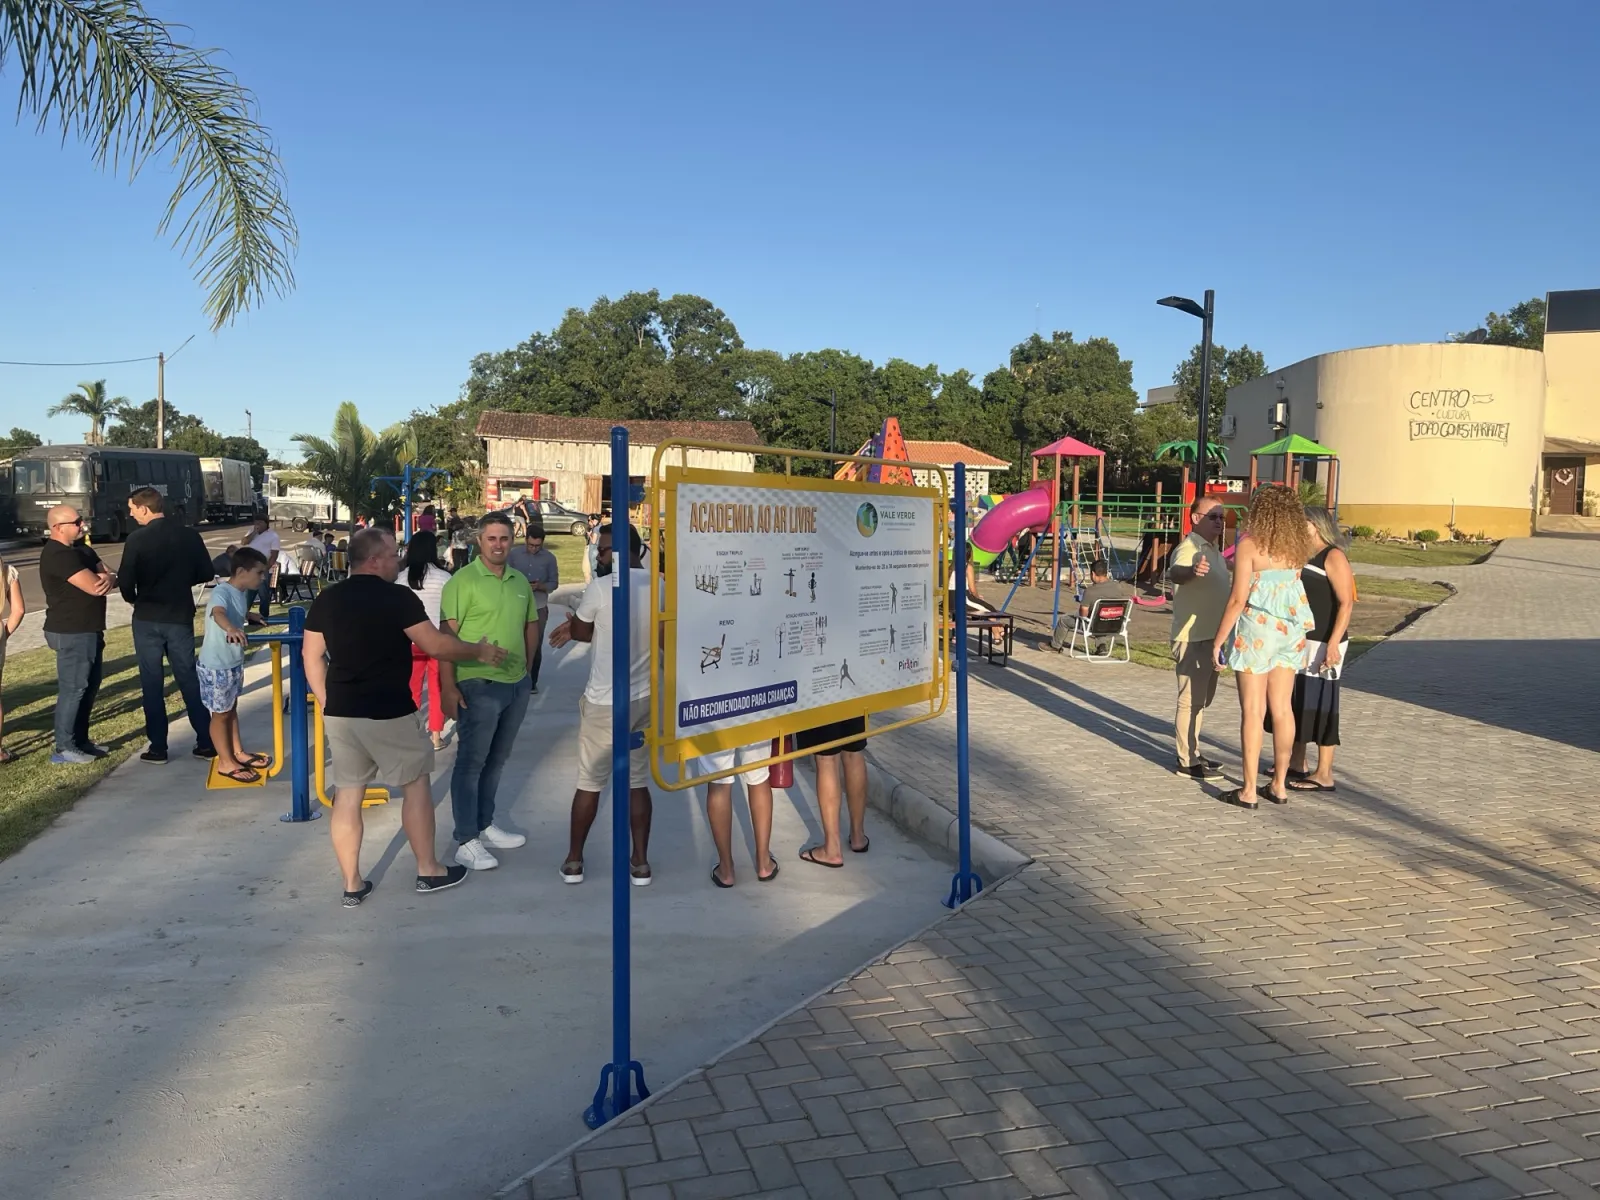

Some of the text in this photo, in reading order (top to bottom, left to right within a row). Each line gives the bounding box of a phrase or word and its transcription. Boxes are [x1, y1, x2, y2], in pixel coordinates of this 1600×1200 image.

[1410, 389, 1470, 409] CENTRO
[689, 502, 818, 533] ACADEMIA AO AR LIVRE
[880, 511, 916, 520] VALE VERDE
[683, 686, 795, 721] NÃO RECOMENDADO PARA CRIANÇAS
